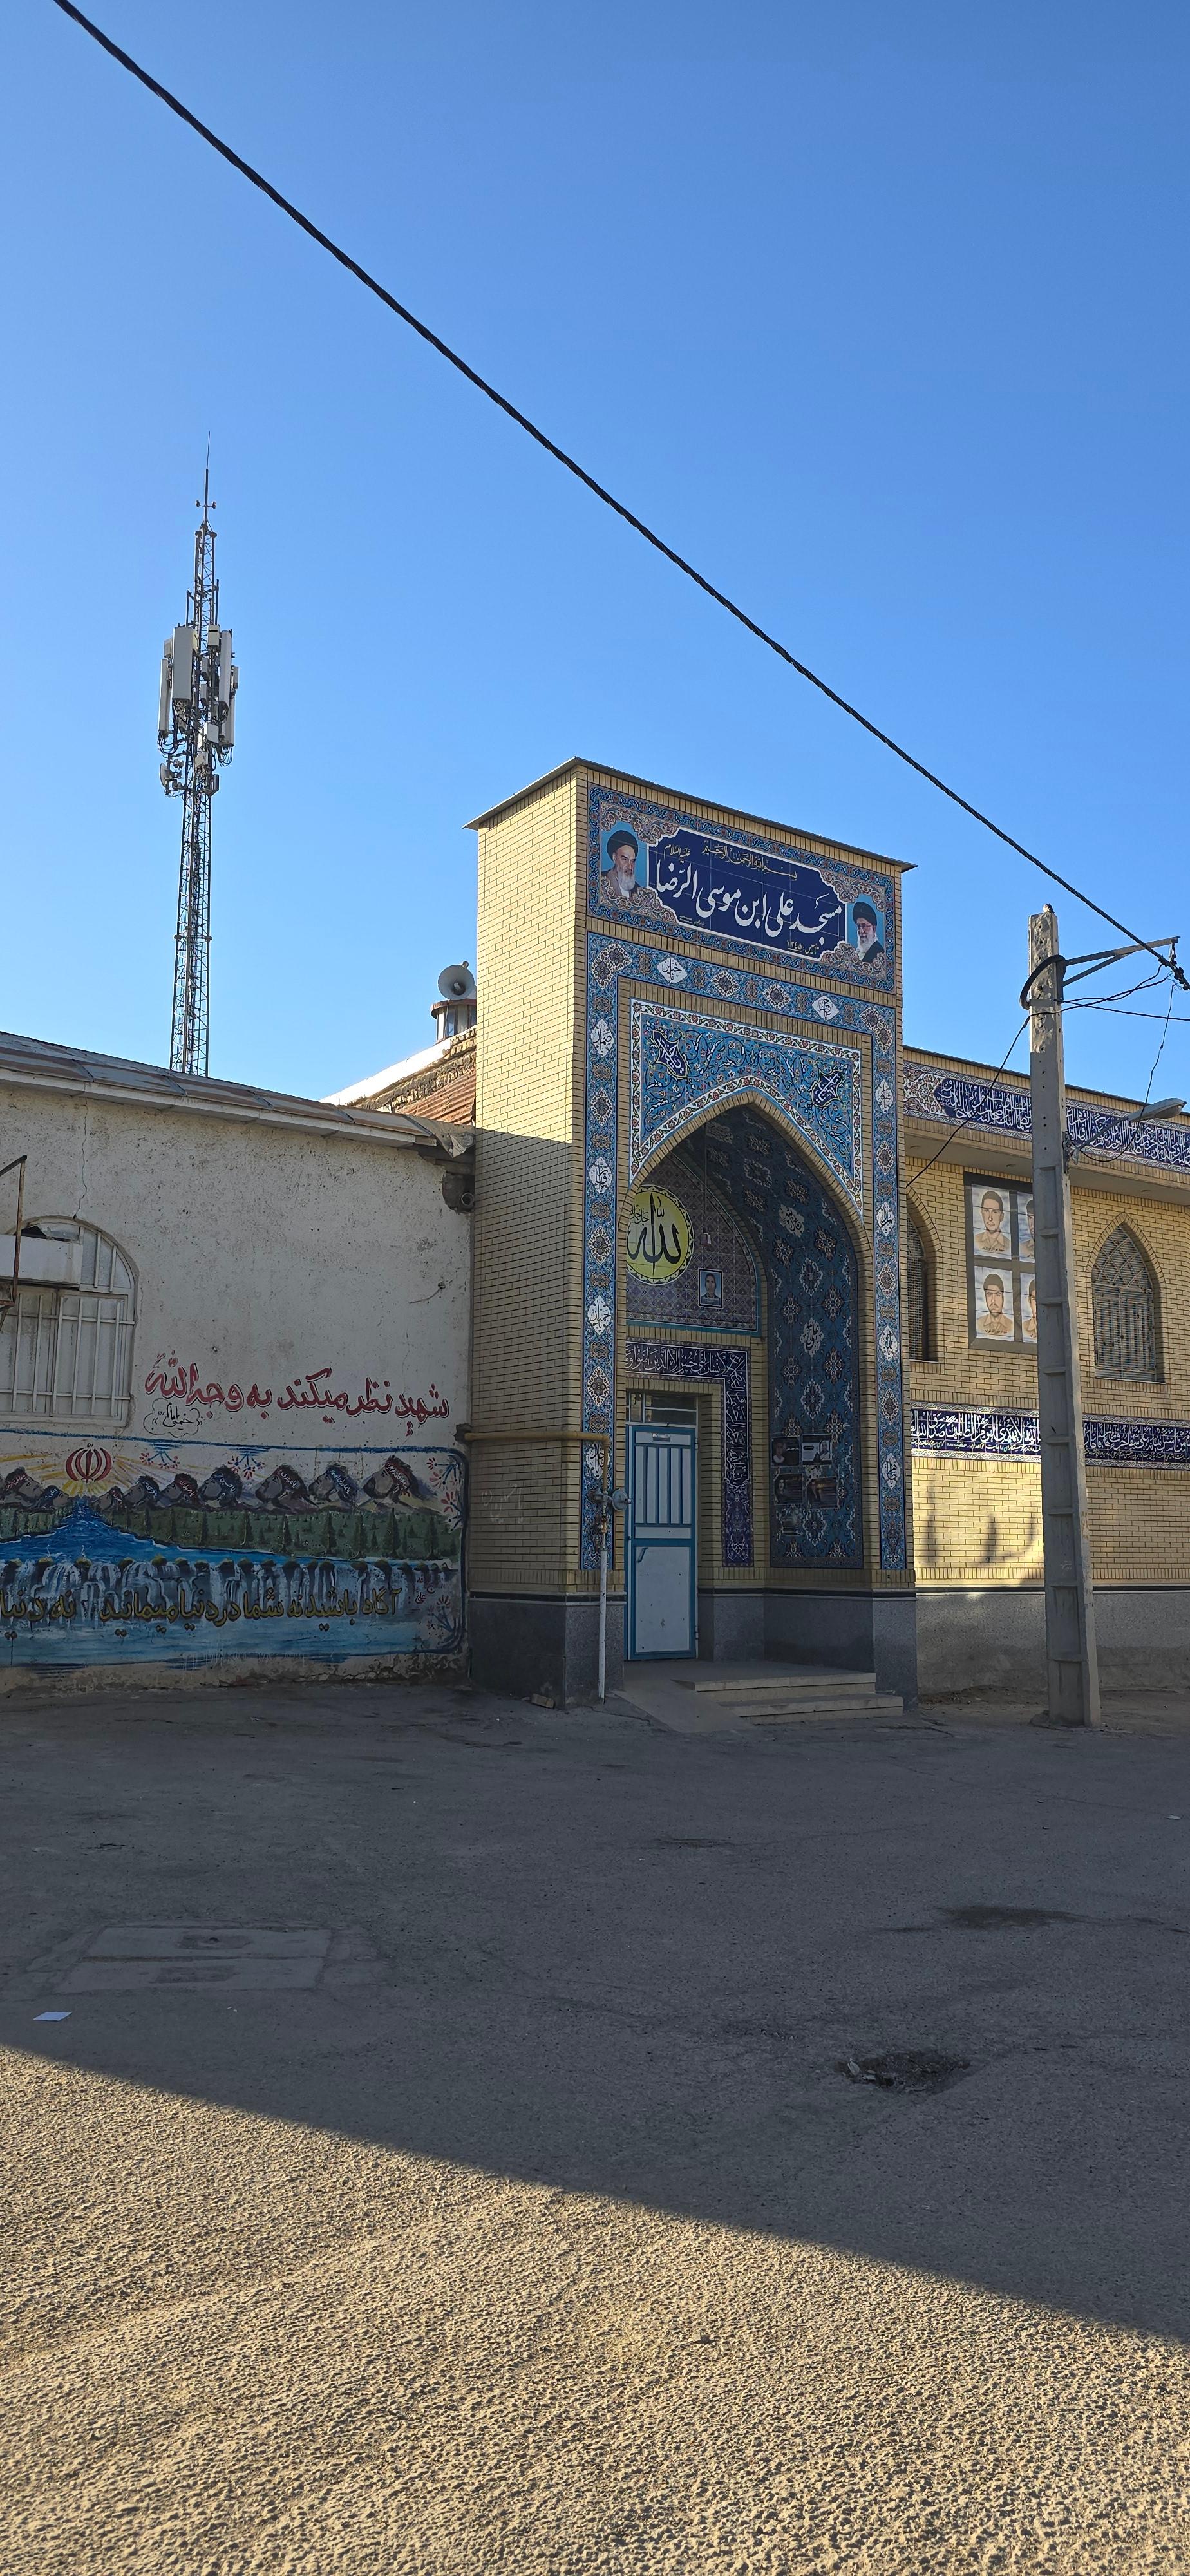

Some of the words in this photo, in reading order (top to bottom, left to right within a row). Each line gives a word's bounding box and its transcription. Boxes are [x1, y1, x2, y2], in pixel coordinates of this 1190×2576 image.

[695, 885, 741, 918] موسی
[735, 892, 768, 929] ابن
[764, 892, 794, 938] علی
[789, 894, 842, 945] مسجد
[628, 1193, 681, 1276] الله
[247, 1383, 273, 1420] به
[345, 1376, 394, 1416] نظر
[393, 1383, 450, 1437] شهید
[50, 1589, 76, 1620] نه
[180, 1588, 218, 1631] دنیا
[212, 1600, 242, 1627] در
[243, 1587, 284, 1620] شما
[287, 1593, 303, 1618] نه
[304, 1586, 358, 1632] باشید
[361, 1586, 403, 1615] آگاه
